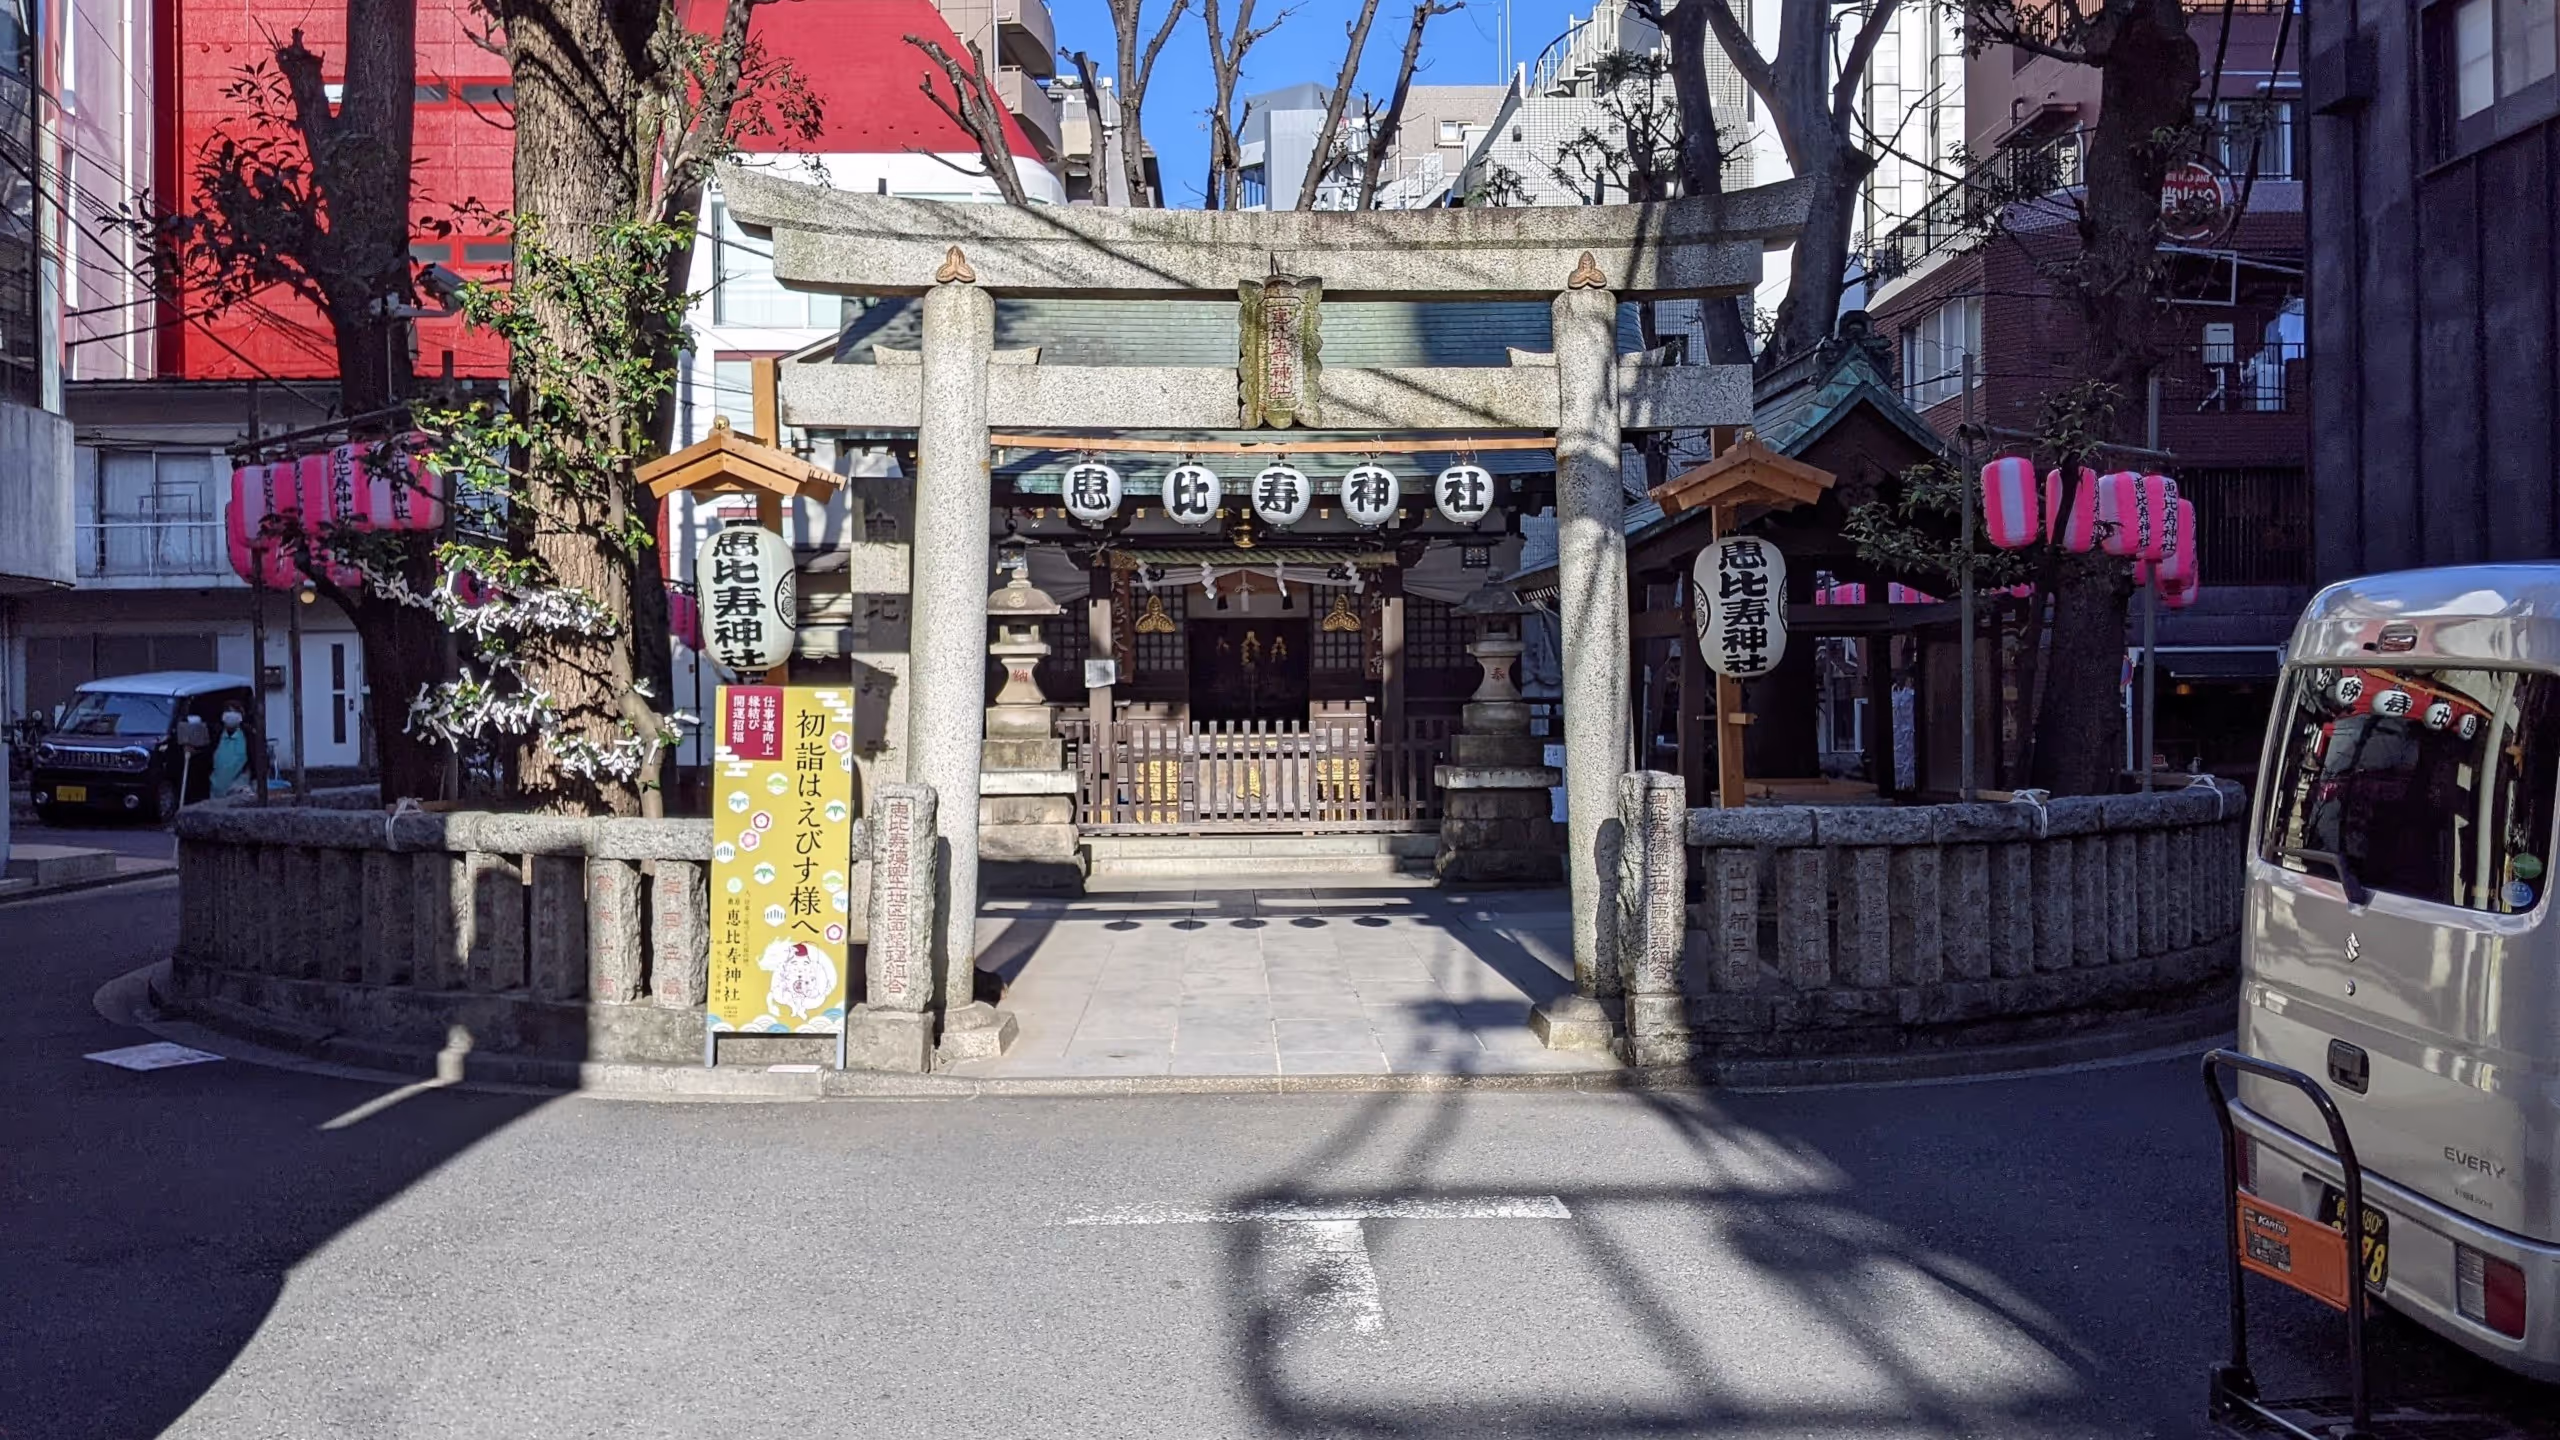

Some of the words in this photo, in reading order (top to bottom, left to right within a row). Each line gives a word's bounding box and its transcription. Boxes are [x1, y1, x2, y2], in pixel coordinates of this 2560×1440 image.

[2134, 477, 2151, 550] 恵比寿神社
[2160, 481, 2178, 552] 恵比寿神社
[712, 531, 768, 667] 恵比寿神社
[1718, 541, 1770, 674] 恵比寿神社
[732, 694, 745, 744] 開運招福
[746, 695, 761, 731] 縁結び
[761, 696, 776, 756] 仕事運向上
[789, 708, 827, 935] 初詣はえびす様へ
[723, 908, 742, 1003] 恵比寿神社
[2444, 1146, 2506, 1178] EVERY
